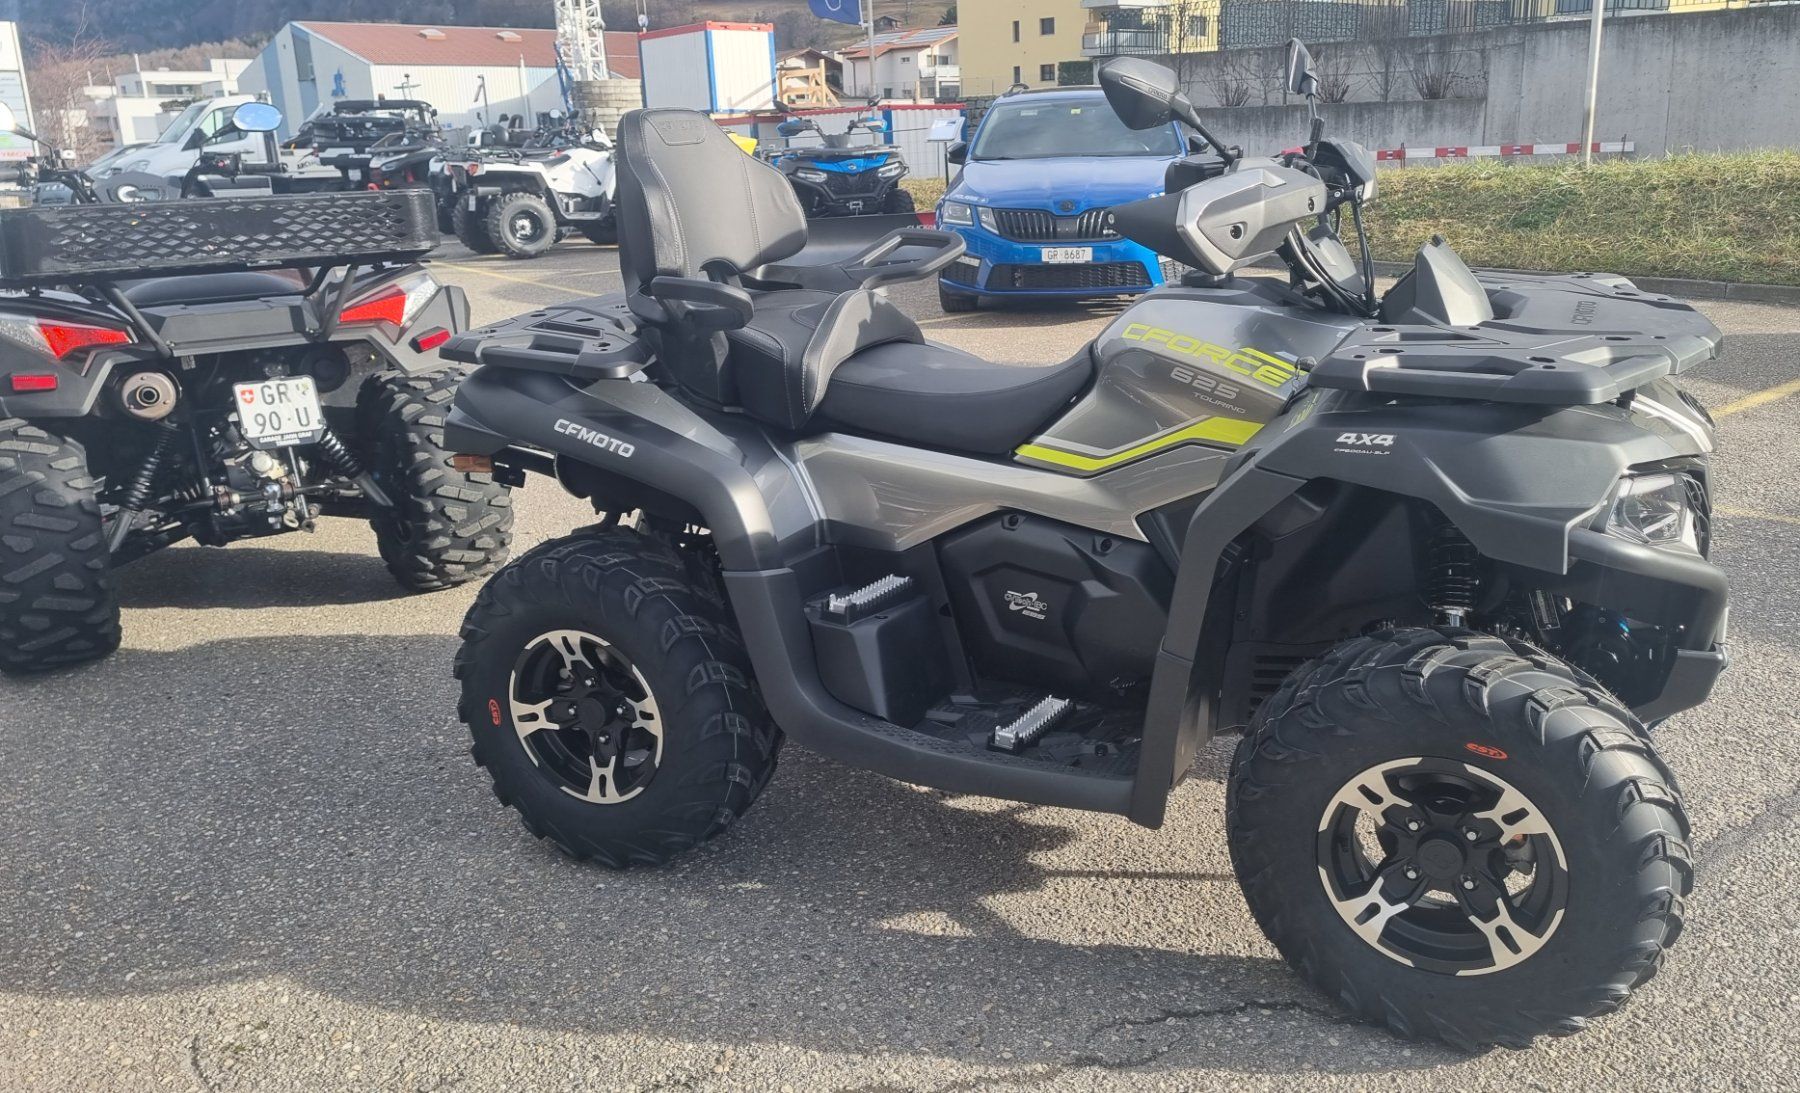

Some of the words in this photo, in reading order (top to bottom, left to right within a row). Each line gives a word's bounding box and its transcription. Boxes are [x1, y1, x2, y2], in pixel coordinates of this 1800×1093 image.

[1047, 249, 1059, 260] GR
[1064, 249, 1086, 260] 8687
[1121, 322, 1295, 388] CFORCE
[260, 382, 292, 406] GR
[1170, 366, 1240, 400] 625
[1192, 391, 1247, 414] TOURING
[553, 418, 636, 458] CFMOTO
